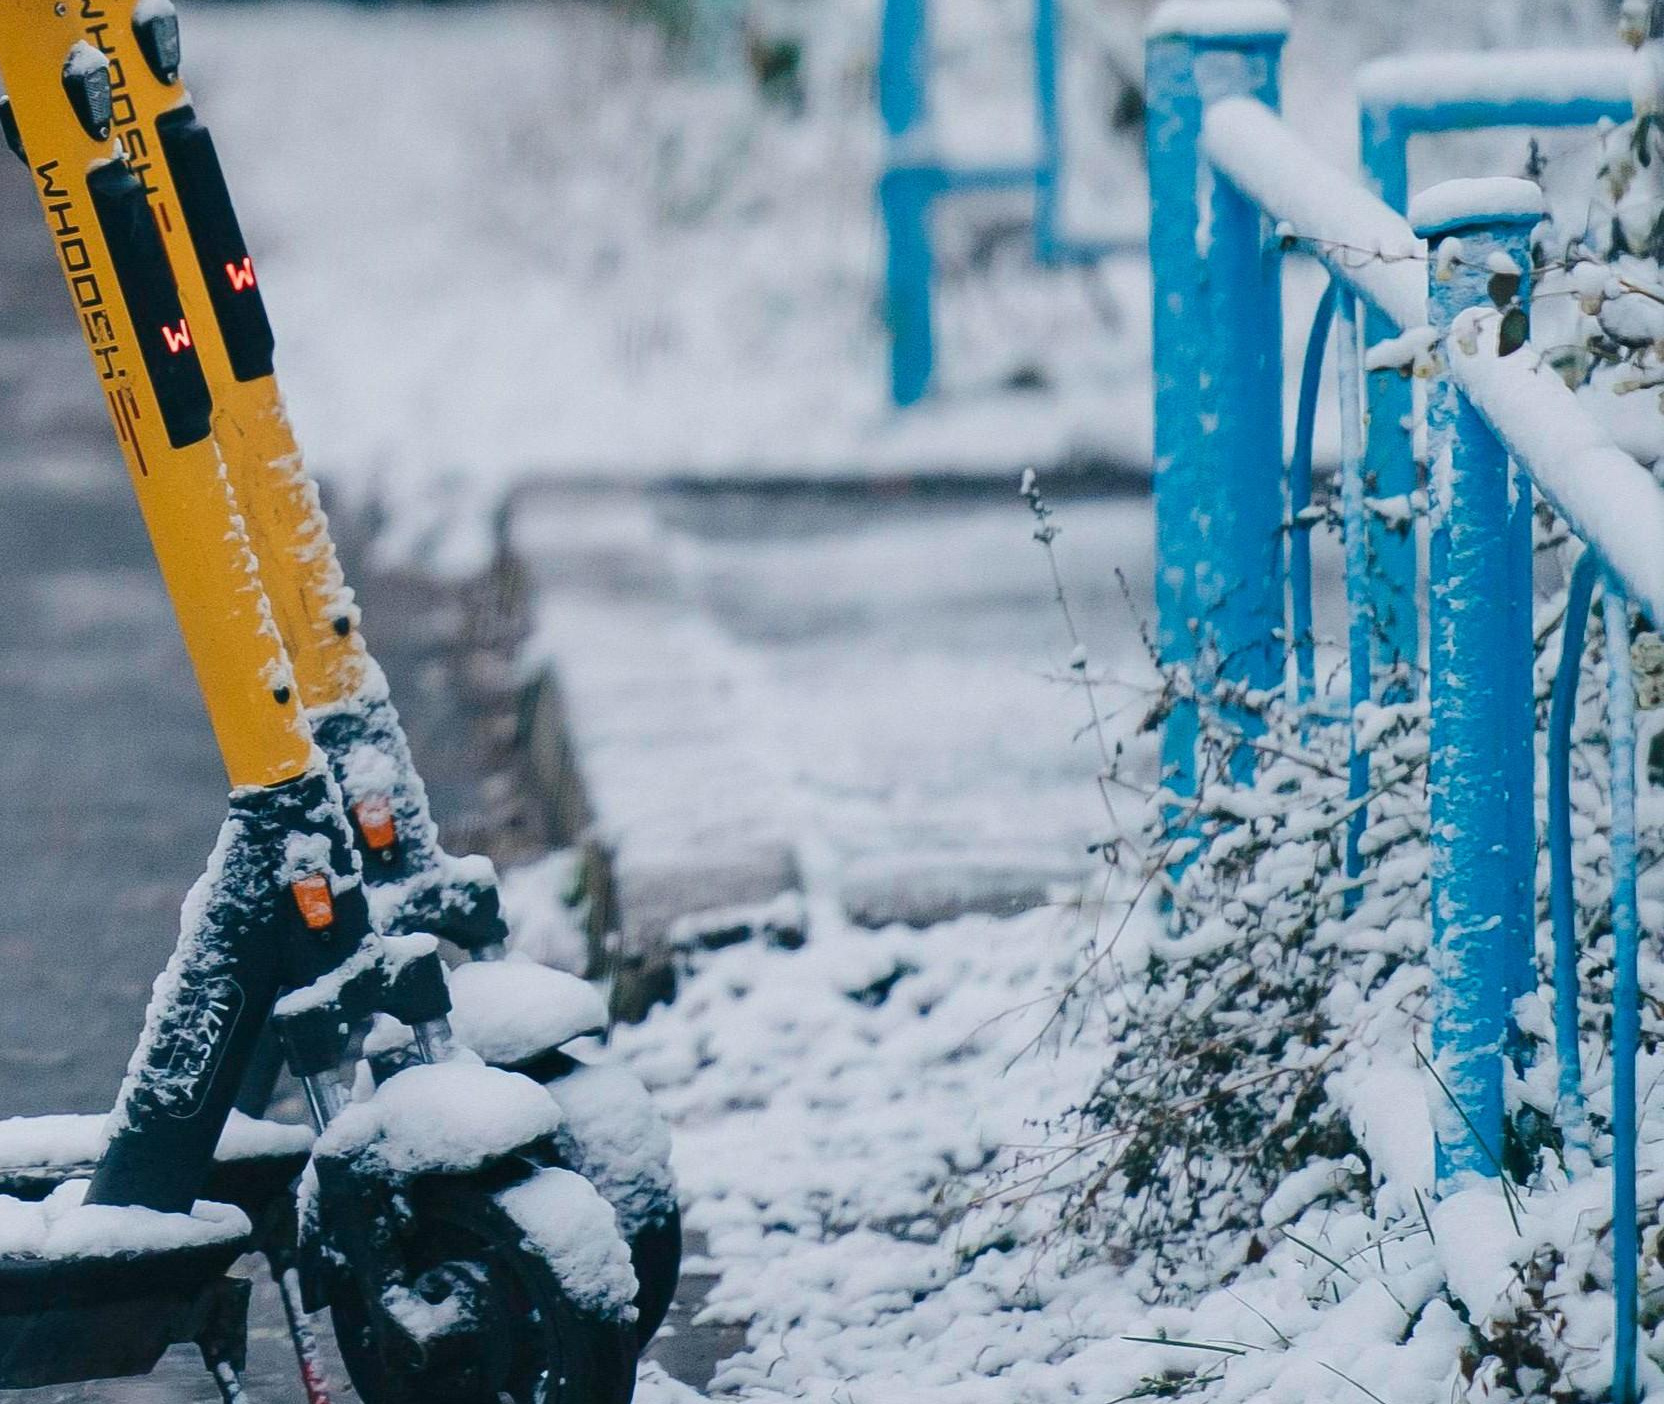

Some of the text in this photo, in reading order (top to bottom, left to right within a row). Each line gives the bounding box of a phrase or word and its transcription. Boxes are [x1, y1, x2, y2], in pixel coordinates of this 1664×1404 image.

[36, 160, 126, 379] WHOOSH
[226, 257, 254, 290] W
[162, 319, 190, 352] W
